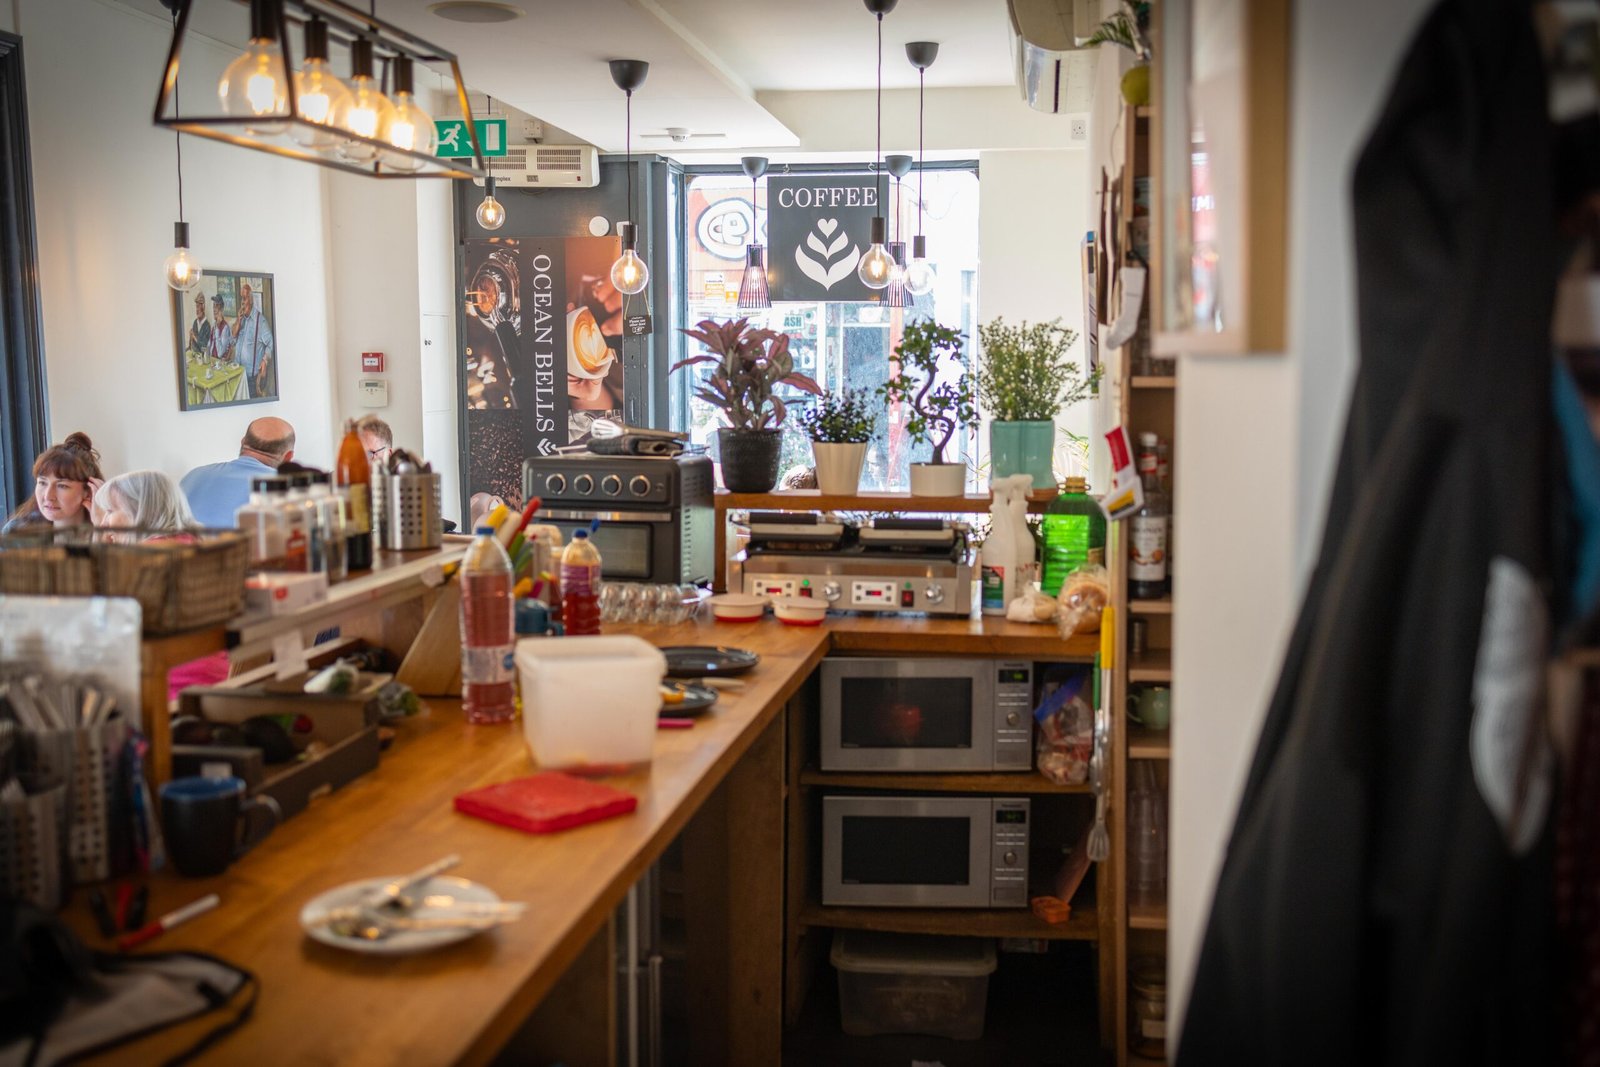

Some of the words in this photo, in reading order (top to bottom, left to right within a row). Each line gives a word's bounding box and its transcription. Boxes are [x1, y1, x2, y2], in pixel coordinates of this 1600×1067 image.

[778, 187, 879, 207] COFFEE
[532, 254, 553, 345] OCEAN
[535, 352, 555, 432] BELLS
